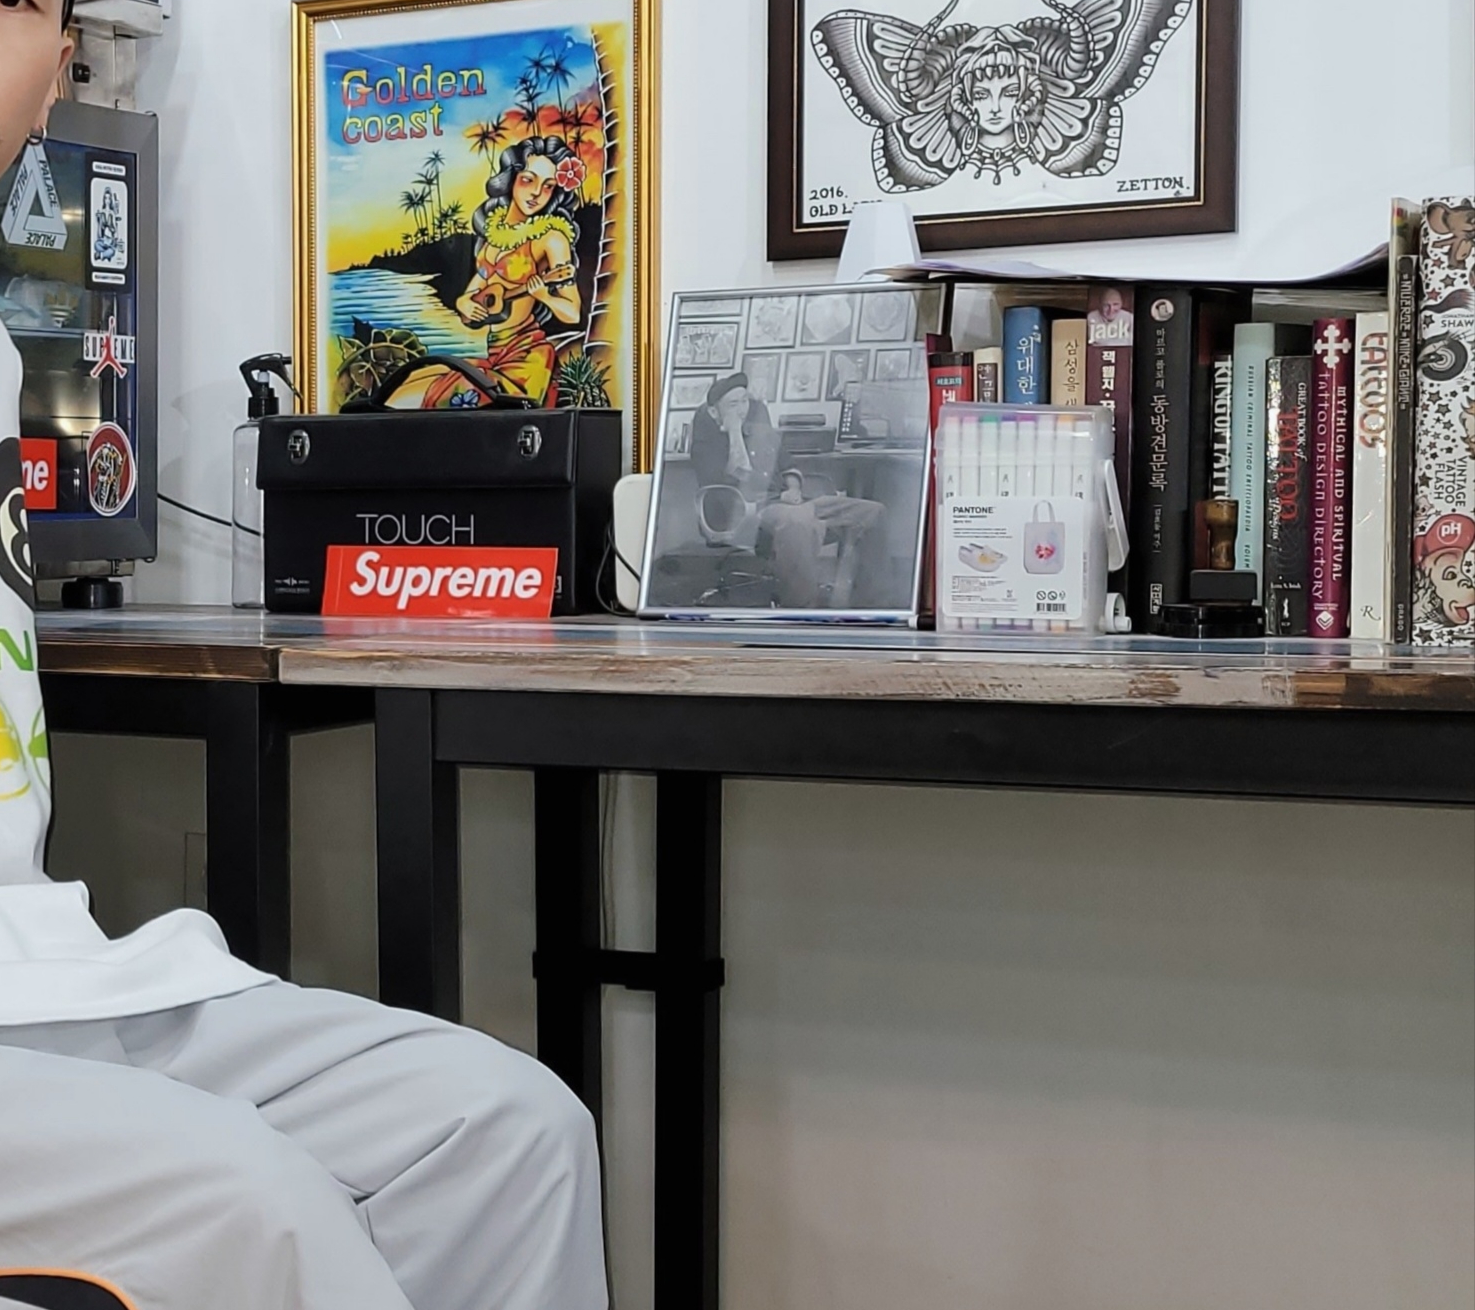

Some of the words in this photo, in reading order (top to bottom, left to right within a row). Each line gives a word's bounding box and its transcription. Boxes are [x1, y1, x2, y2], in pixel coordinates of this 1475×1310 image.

[340, 64, 487, 108] Golden
[341, 100, 445, 145] coast
[39, 159, 59, 208] PALACE
[26, 232, 56, 248] PALACE
[1088, 320, 1130, 344] jack
[1214, 362, 1232, 413] KING
[1298, 383, 1306, 416] GREAT
[1317, 371, 1330, 434] TATTOO
[1148, 395, 1169, 493] 동방견문록
[1297, 419, 1305, 445] BOOK
[1336, 386, 1346, 461] MYTHICAL
[1278, 406, 1300, 521] TATTOO
[1315, 443, 1326, 499] DESIGN
[1335, 469, 1344, 498] AND
[1433, 463, 1444, 500] FLASH
[1444, 458, 1456, 504] TATTOO
[1456, 456, 1466, 507] VINTAGE
[356, 514, 474, 544] TOUCH
[1332, 506, 1344, 581] SPIRITUAL
[1441, 522, 1461, 538] pH
[1311, 508, 1326, 600] DIRECTORY
[350, 551, 542, 610] Supreme
